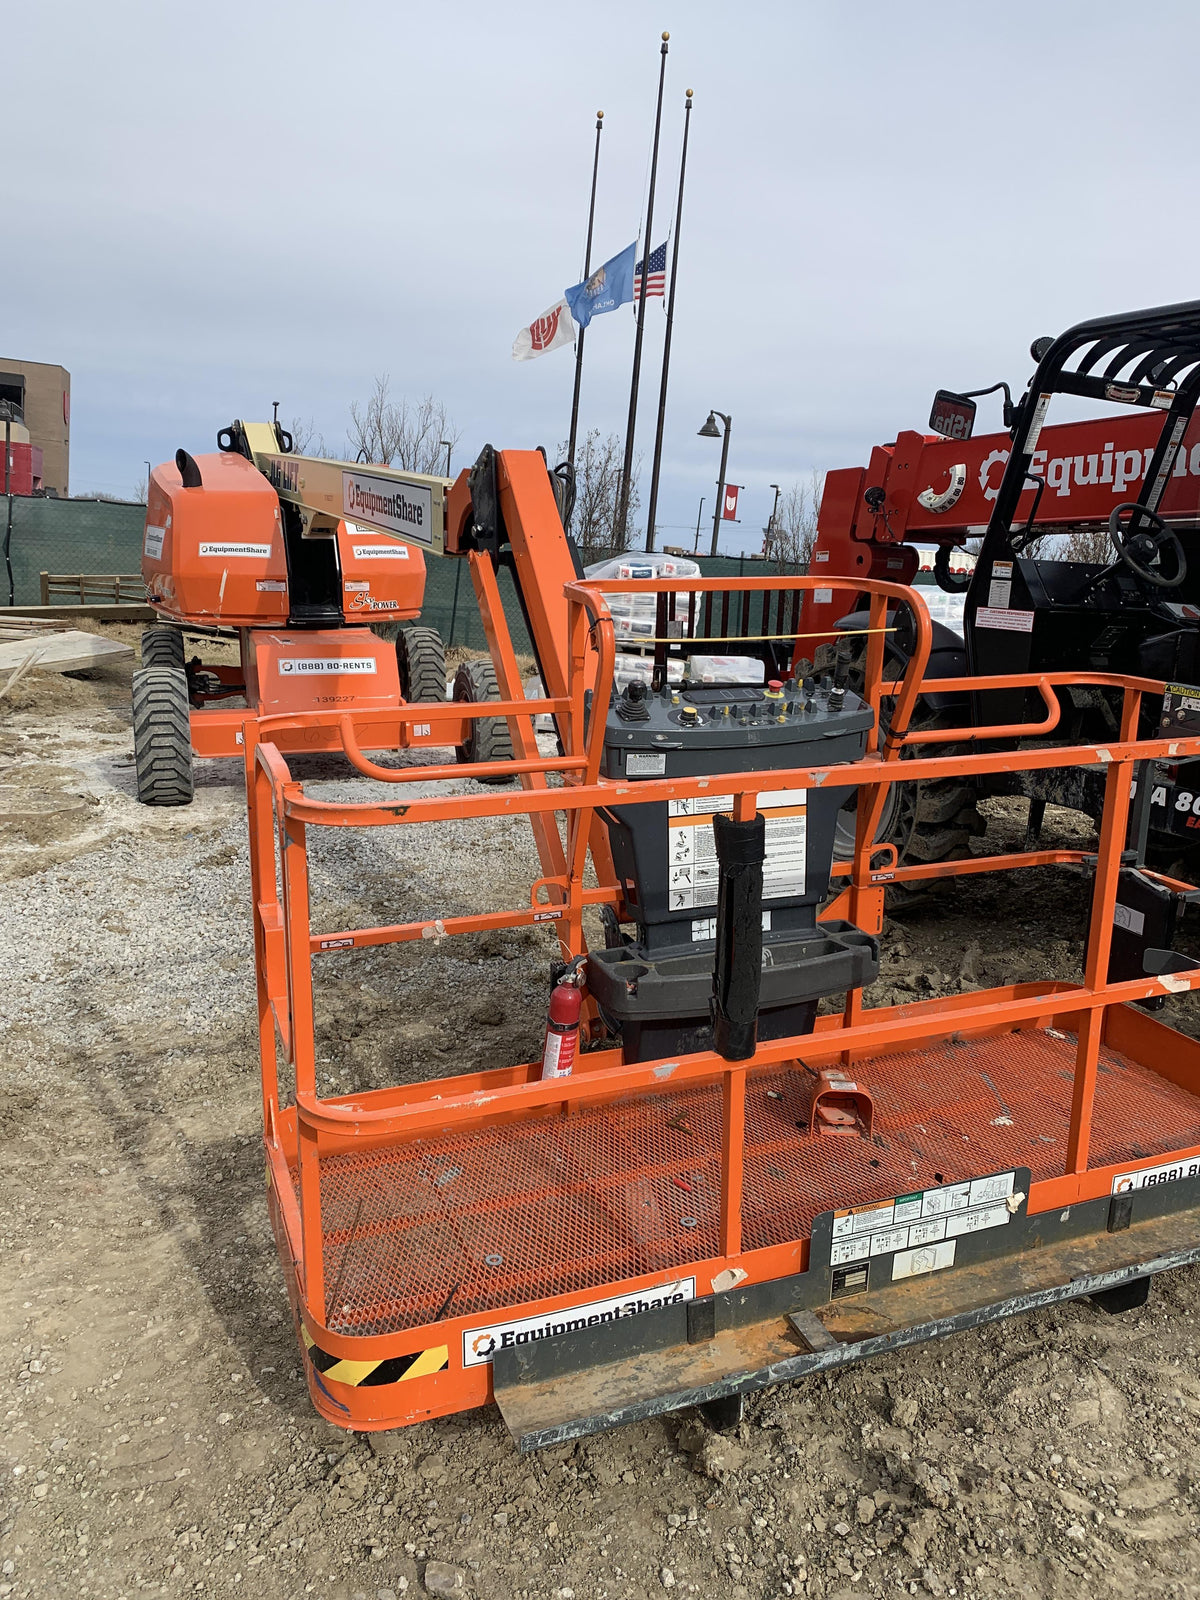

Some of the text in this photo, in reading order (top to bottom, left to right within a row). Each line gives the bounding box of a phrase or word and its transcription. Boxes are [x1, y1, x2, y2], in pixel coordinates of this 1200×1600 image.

[355, 483, 423, 526] EquipmentShare
[208, 545, 268, 554] EquipmentShare
[362, 548, 406, 556] EquipmentShare
[297, 662, 373, 670] (888) 80-RENTS
[315, 695, 356, 703] 139227
[1142, 1166, 1184, 1188] (888)
[499, 1292, 685, 1349] EquipmentShare
